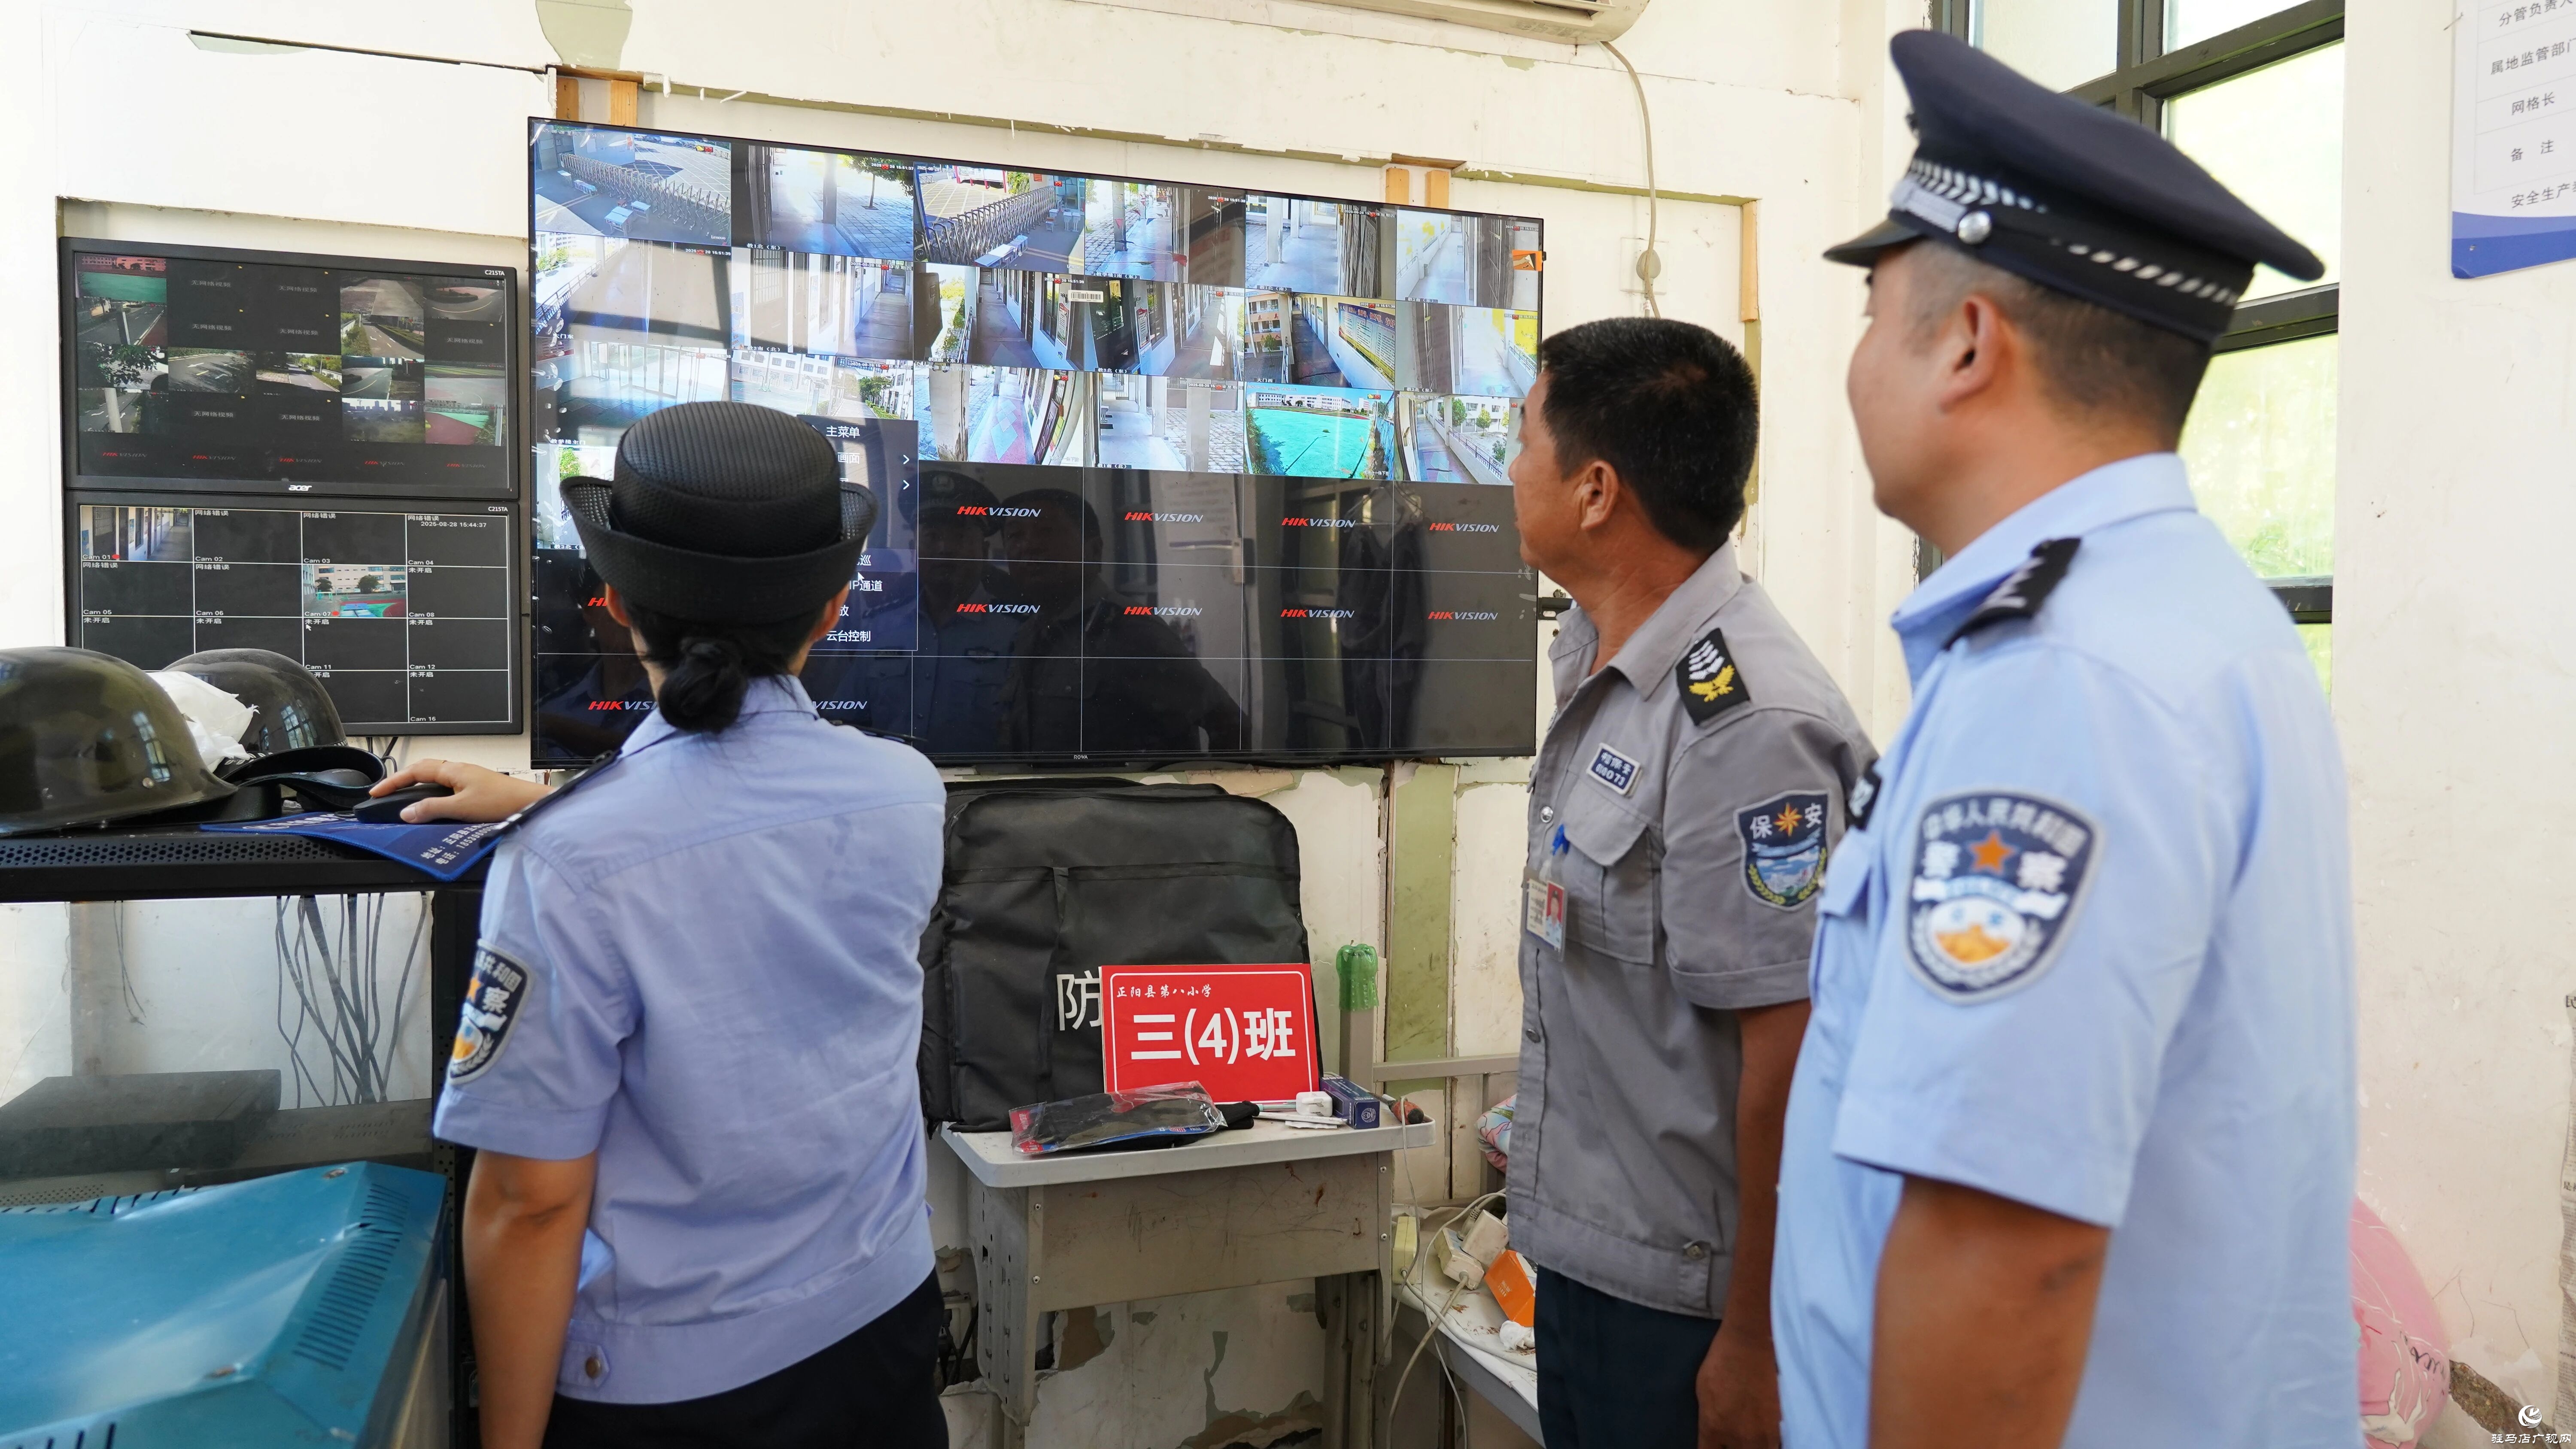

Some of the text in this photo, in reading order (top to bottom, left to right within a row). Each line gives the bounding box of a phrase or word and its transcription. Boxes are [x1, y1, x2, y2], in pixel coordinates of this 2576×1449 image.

[2511, 91, 2555, 115] 网格长
[2511, 139, 2554, 162] 备 注
[826, 425, 860, 439] 主菜单
[957, 506, 1041, 517] HIKVISION
[1124, 512, 1203, 523] HIKVISION
[1282, 518, 1356, 528] HIKVISION
[1429, 523, 1500, 533] HIKVISION
[849, 580, 883, 591] IP通道
[957, 604, 1041, 613] HIKVISION
[1124, 606, 1203, 616] HIKVISION
[1281, 609, 1355, 618] HIKVISION
[1428, 611, 1498, 620] HIKVISION
[826, 630, 871, 643] 云台控制
[1750, 802, 1823, 839] 保 安
[1116, 983, 1212, 999] 正阳县第八小学
[482, 986, 510, 1014] 察
[1057, 970, 1100, 1031] 防
